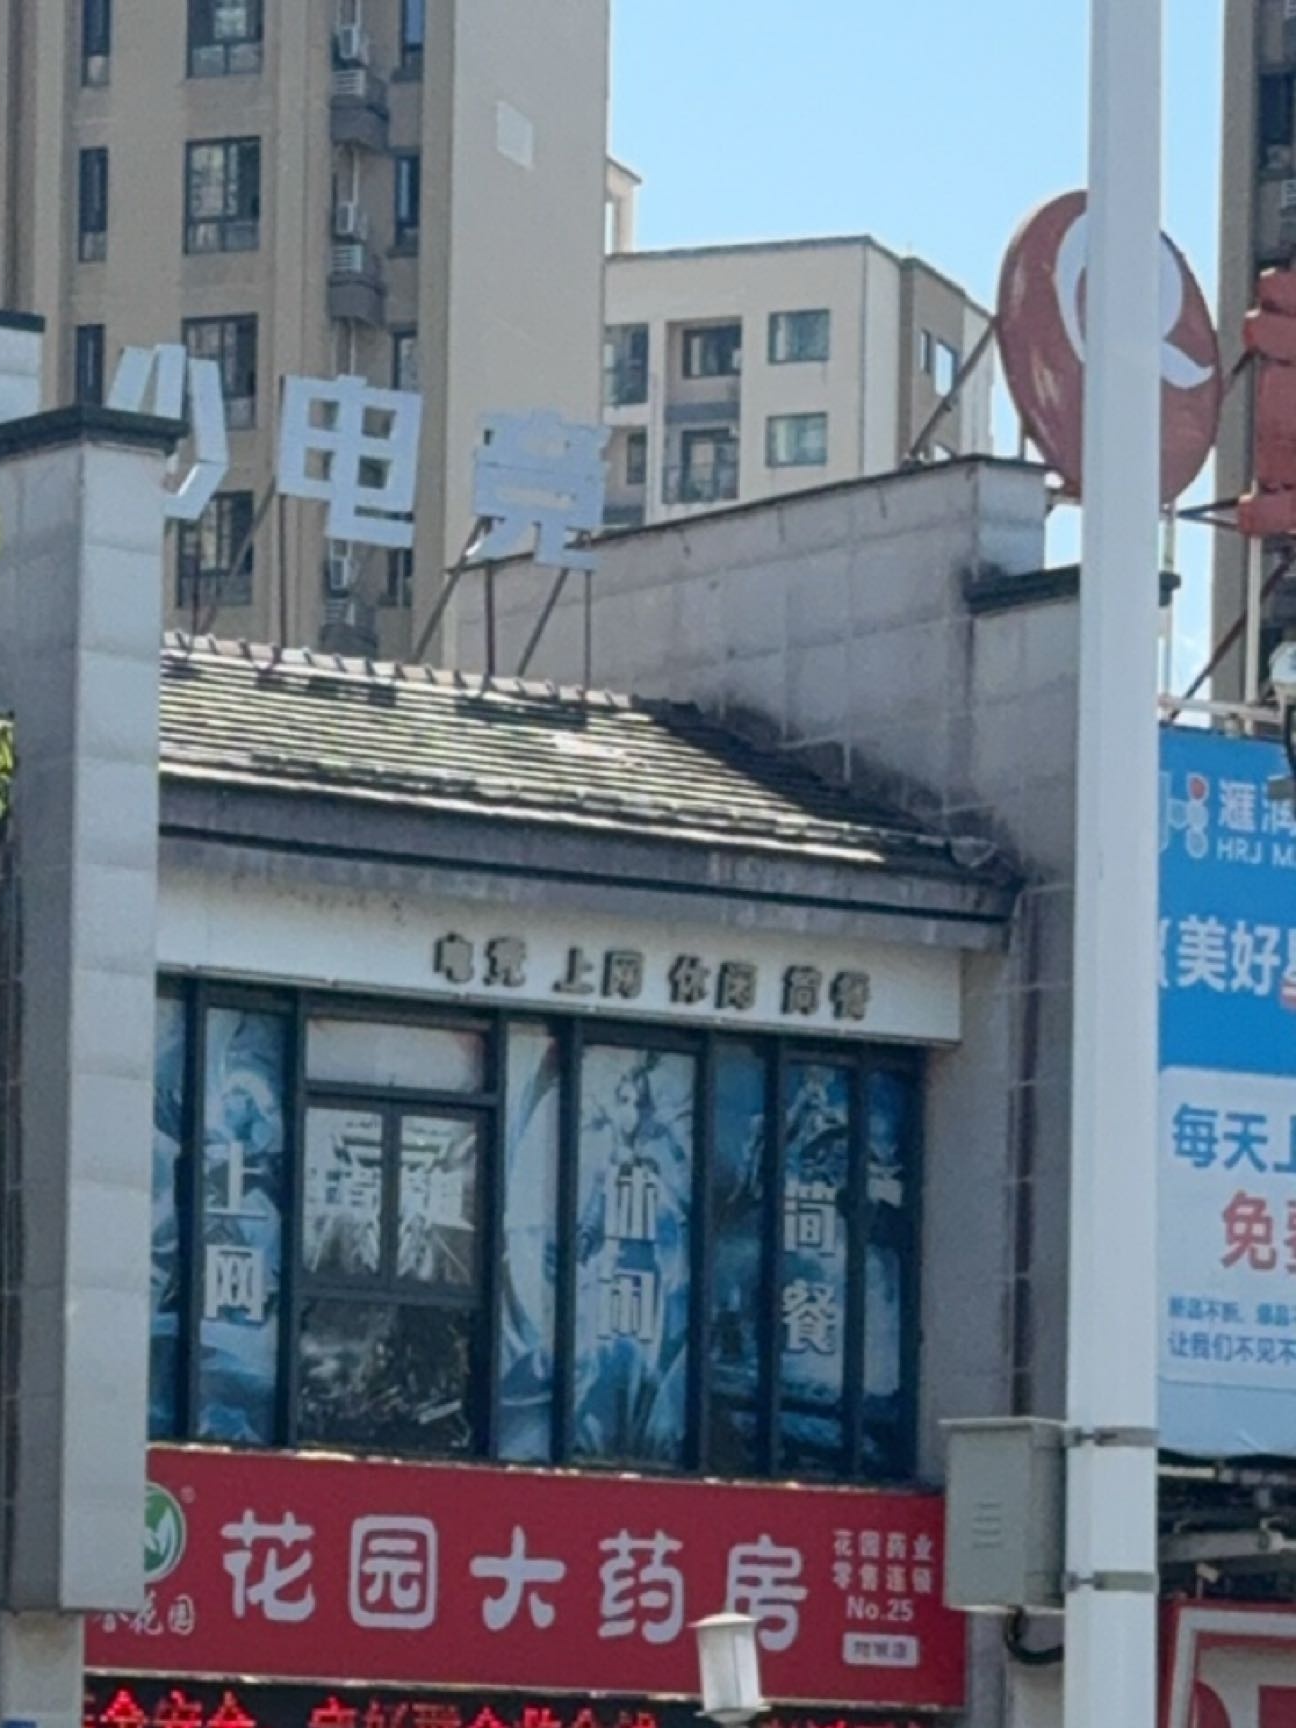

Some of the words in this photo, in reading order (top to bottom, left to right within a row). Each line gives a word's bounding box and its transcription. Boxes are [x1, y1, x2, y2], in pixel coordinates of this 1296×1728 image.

[1161, 914, 1296, 1000] 美好
[206, 1142, 269, 1321] 上网
[1221, 1190, 1296, 1274] 免
[220, 1509, 808, 1651] 花园大药房
[846, 1596, 914, 1621] No.25
